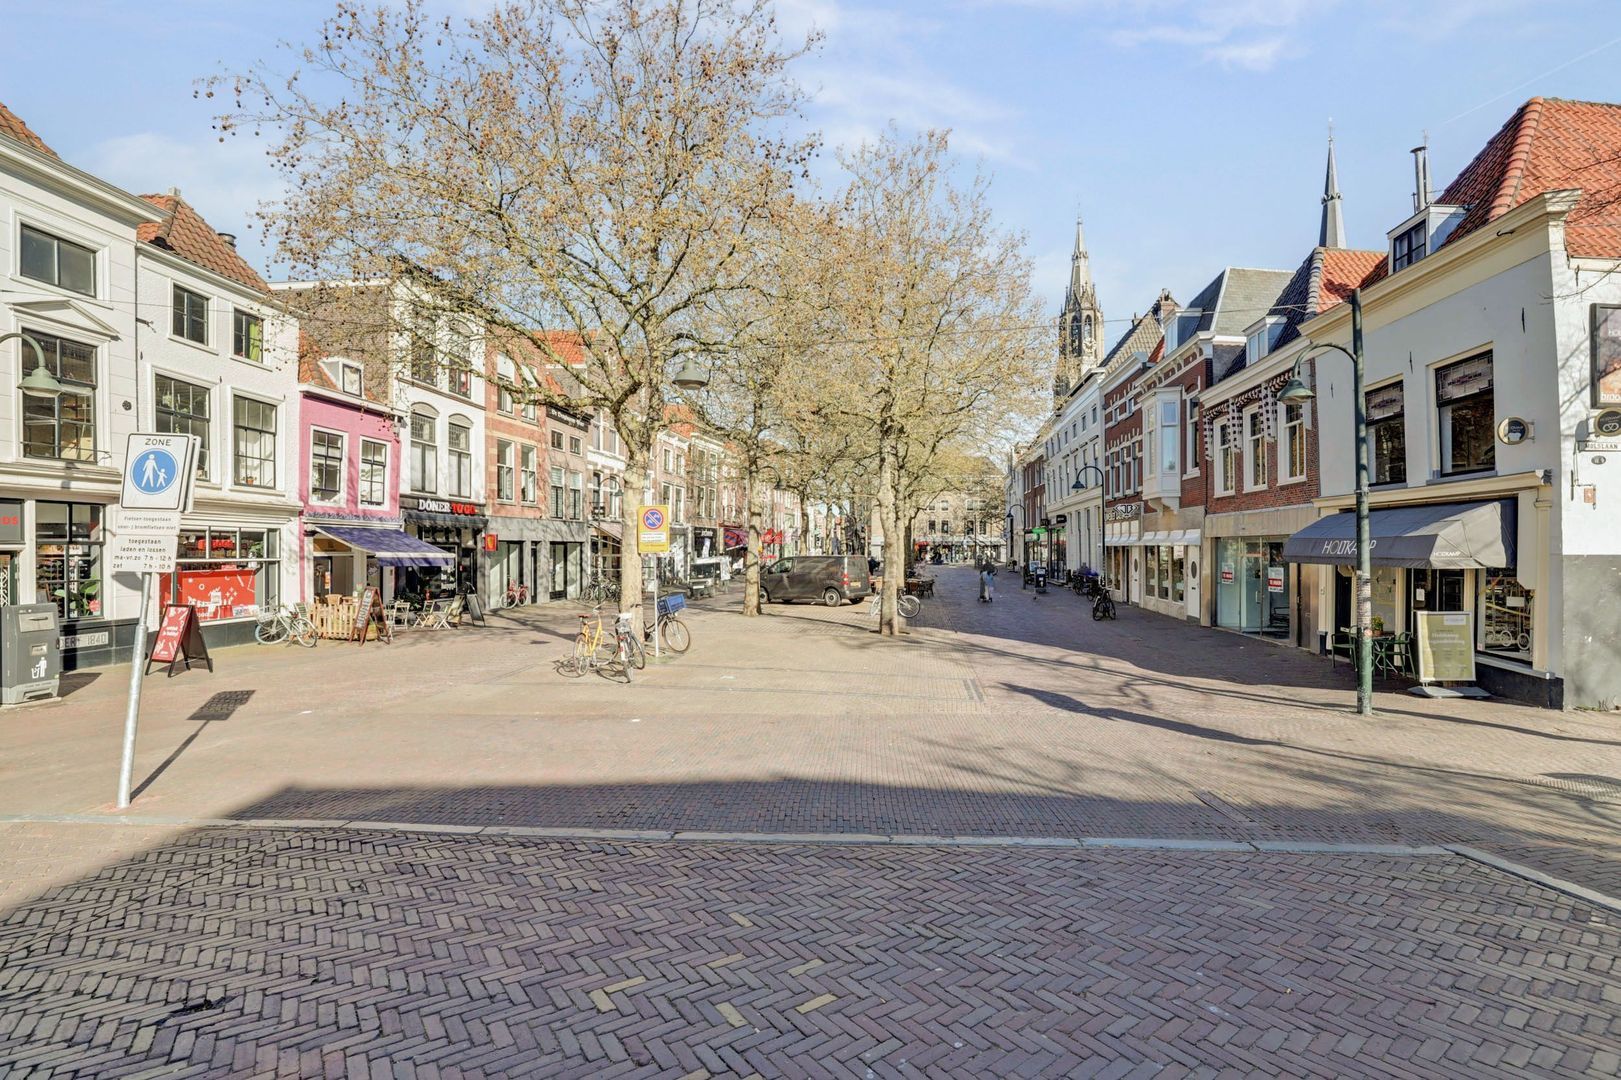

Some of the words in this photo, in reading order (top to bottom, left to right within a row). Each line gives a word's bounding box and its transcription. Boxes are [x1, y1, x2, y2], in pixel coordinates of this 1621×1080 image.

[145, 438, 172, 447] ZONE
[1321, 540, 1377, 555] HOLTKAP
[88, 633, 106, 645] 1840
